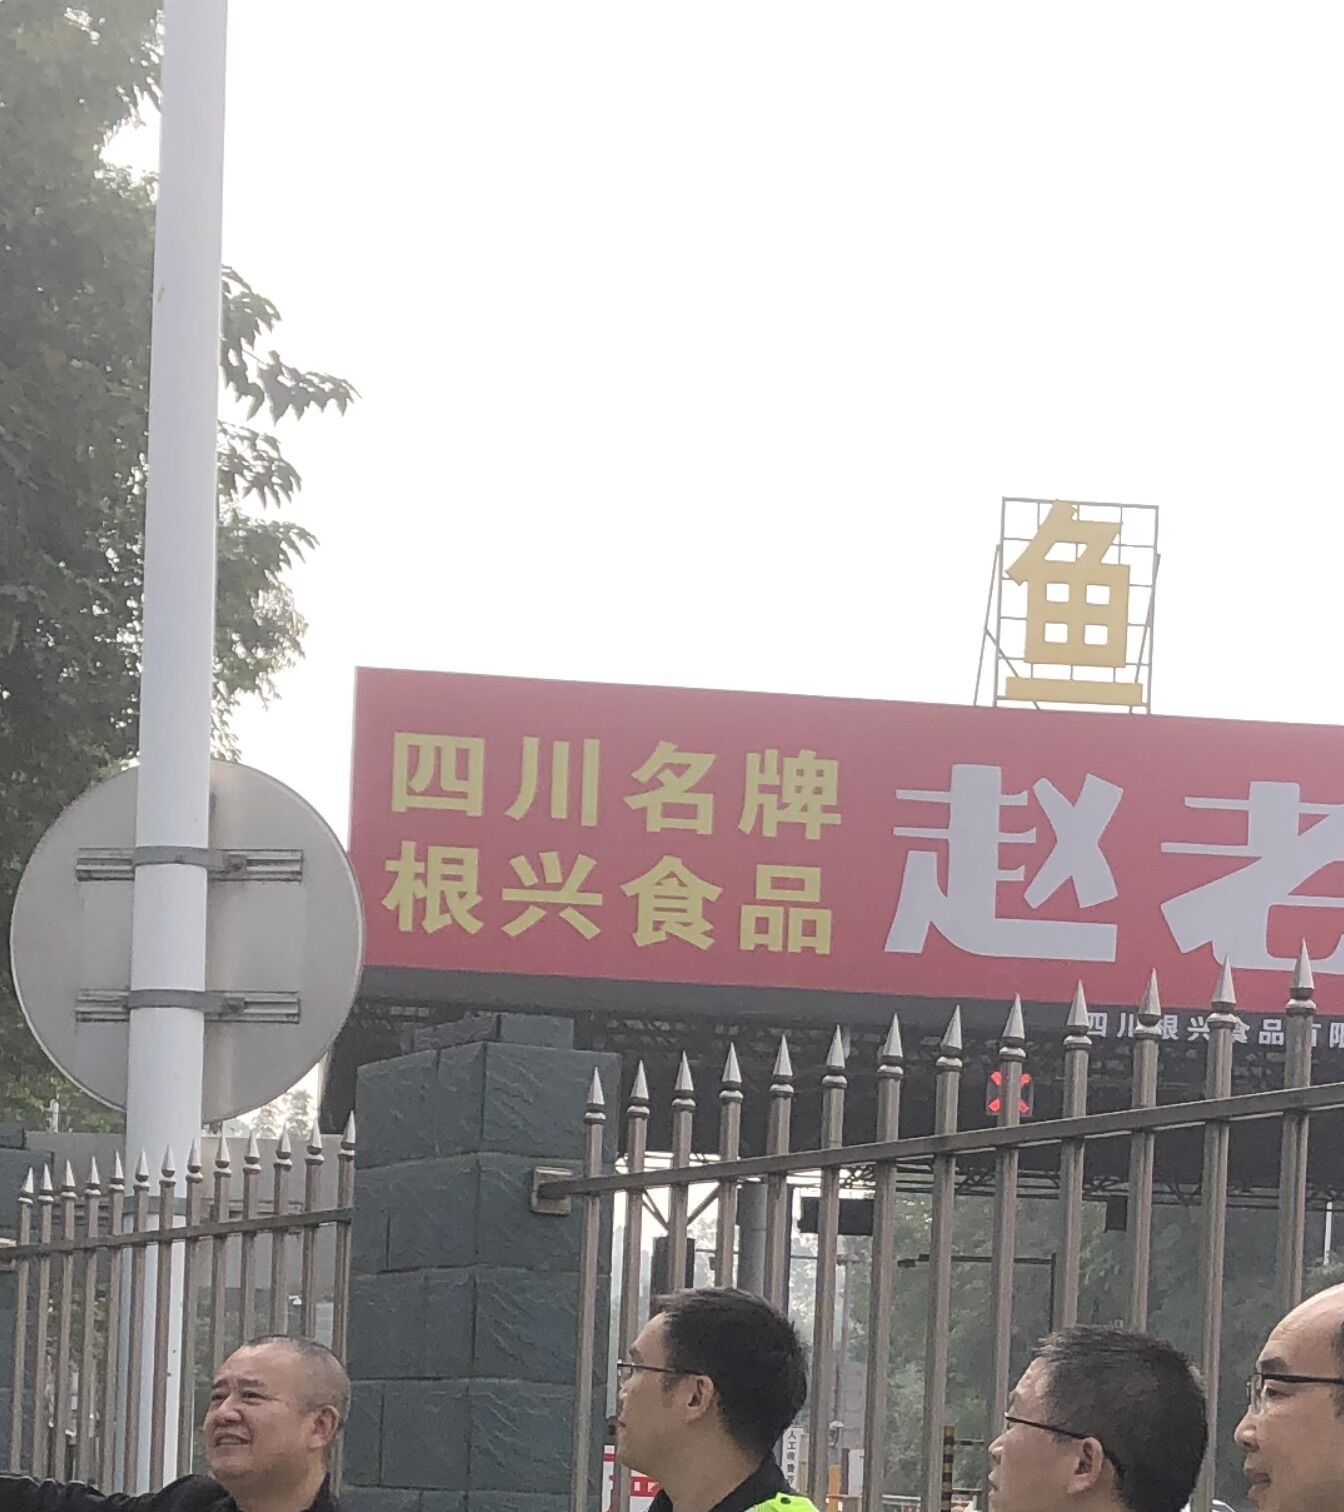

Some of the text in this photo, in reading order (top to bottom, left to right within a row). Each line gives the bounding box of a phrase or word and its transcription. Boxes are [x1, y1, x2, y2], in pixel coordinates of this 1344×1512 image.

[1004, 499, 1144, 707] 鱼
[390, 731, 843, 840] 四川名牌
[380, 840, 833, 955] 根兴食品
